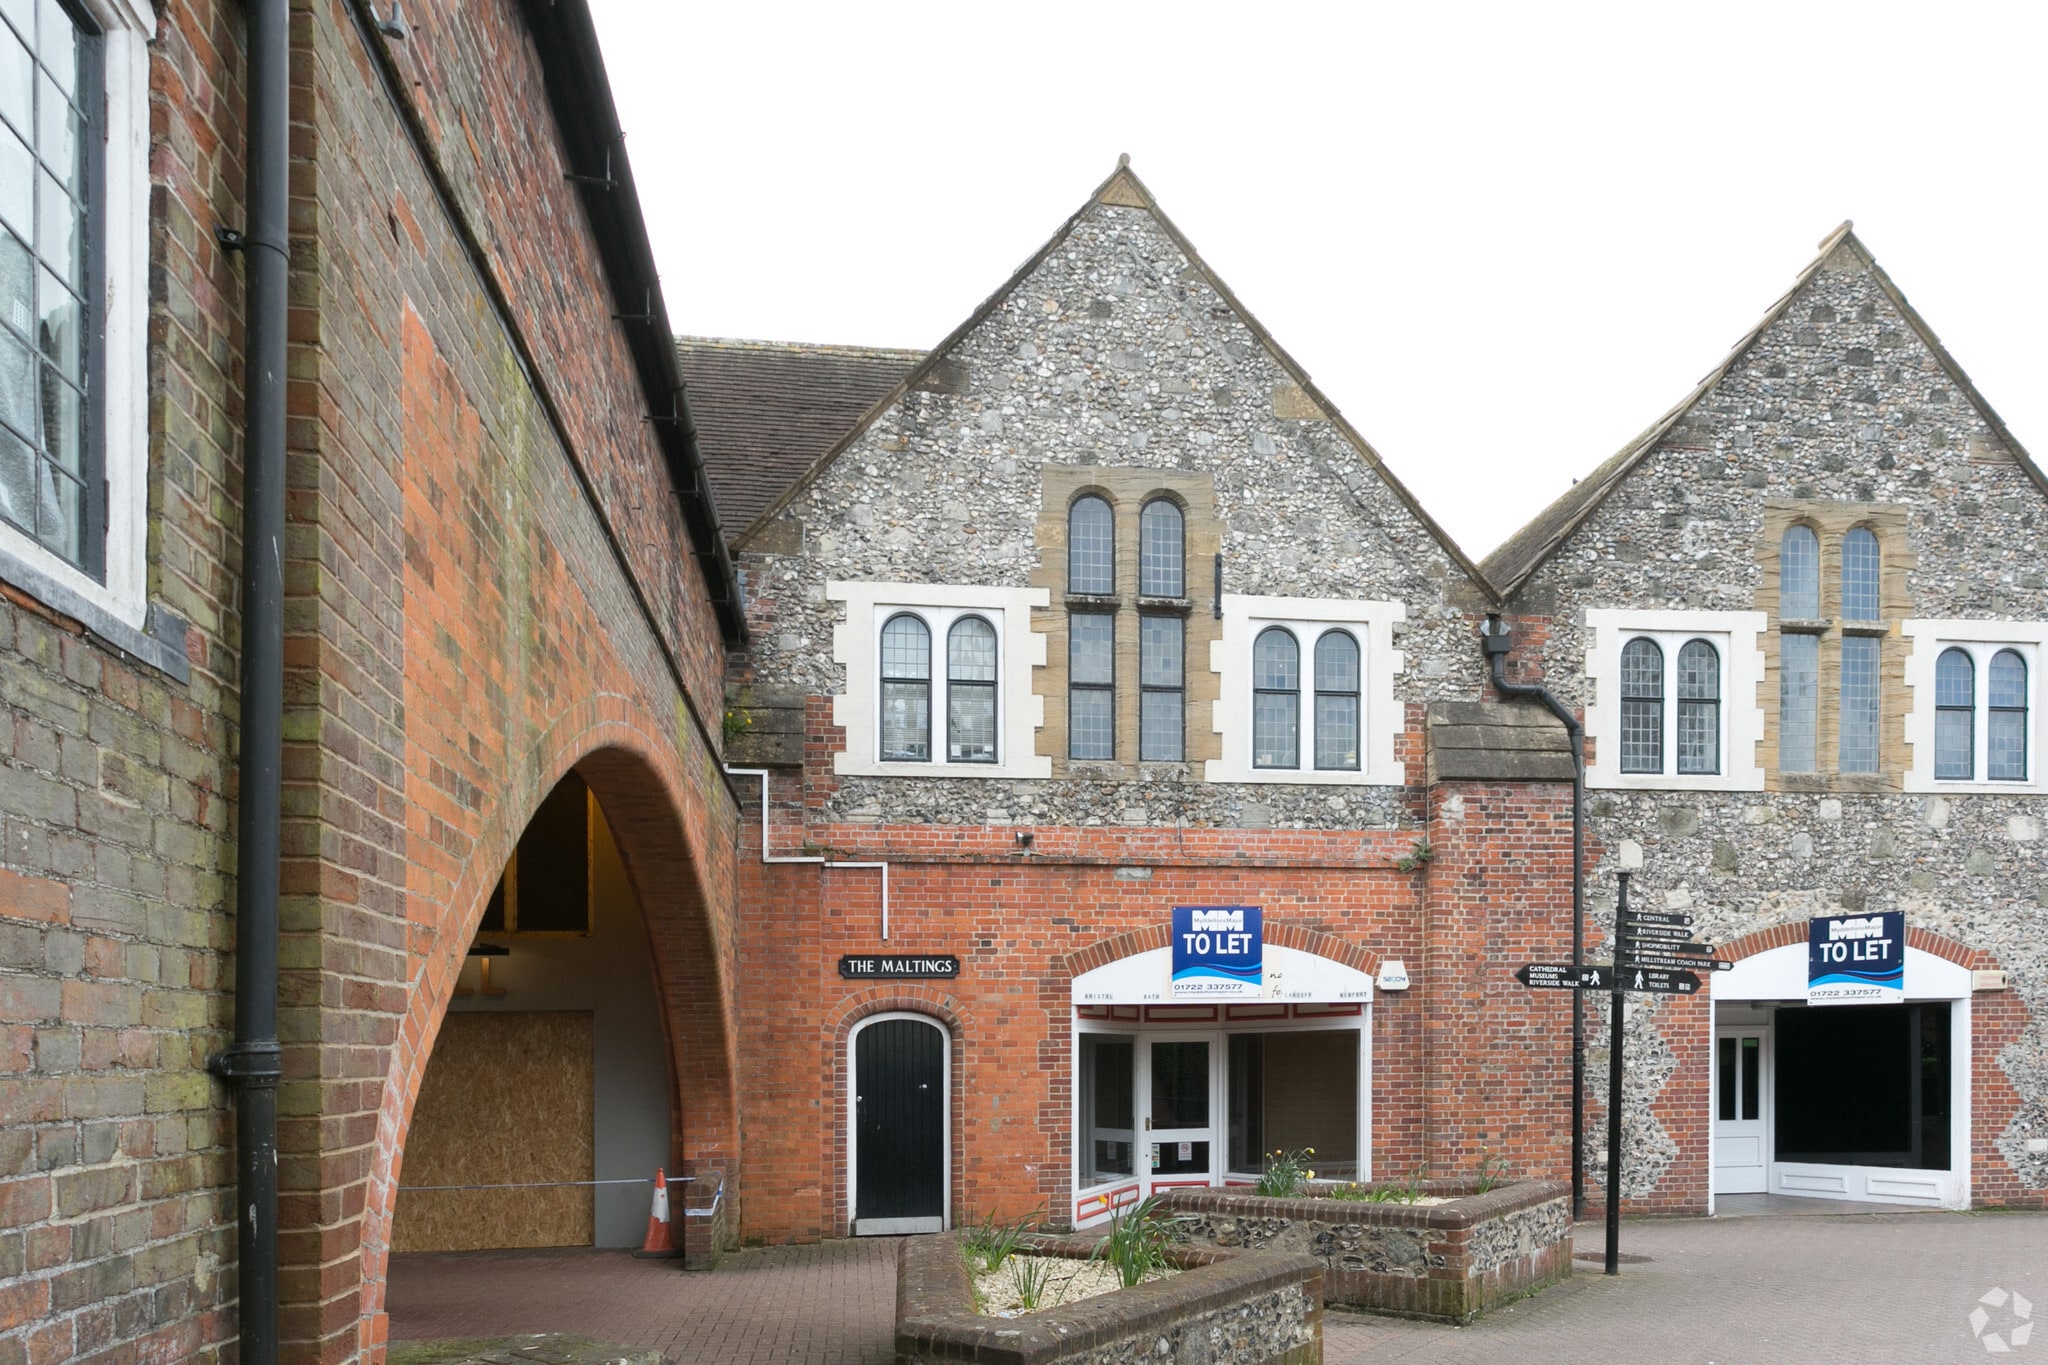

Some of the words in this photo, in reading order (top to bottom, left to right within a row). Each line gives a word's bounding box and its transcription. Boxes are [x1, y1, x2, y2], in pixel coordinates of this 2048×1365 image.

[1643, 914, 1670, 922] CENTRAL
[1642, 928, 1671, 936] RIVERSIDE
[1183, 933, 1210, 954] TO
[1216, 934, 1252, 954] LET
[1641, 942, 1680, 950] SHOPMOBILITY
[1820, 942, 1847, 962] TO
[1853, 939, 1892, 961] LET
[1640, 956, 1675, 965] MILLSTREAM
[847, 960, 875, 972] THE
[881, 960, 952, 973] MALTINGS
[1529, 965, 1567, 973] CATHEDRAL
[1648, 981, 1669, 989] TOILETS
